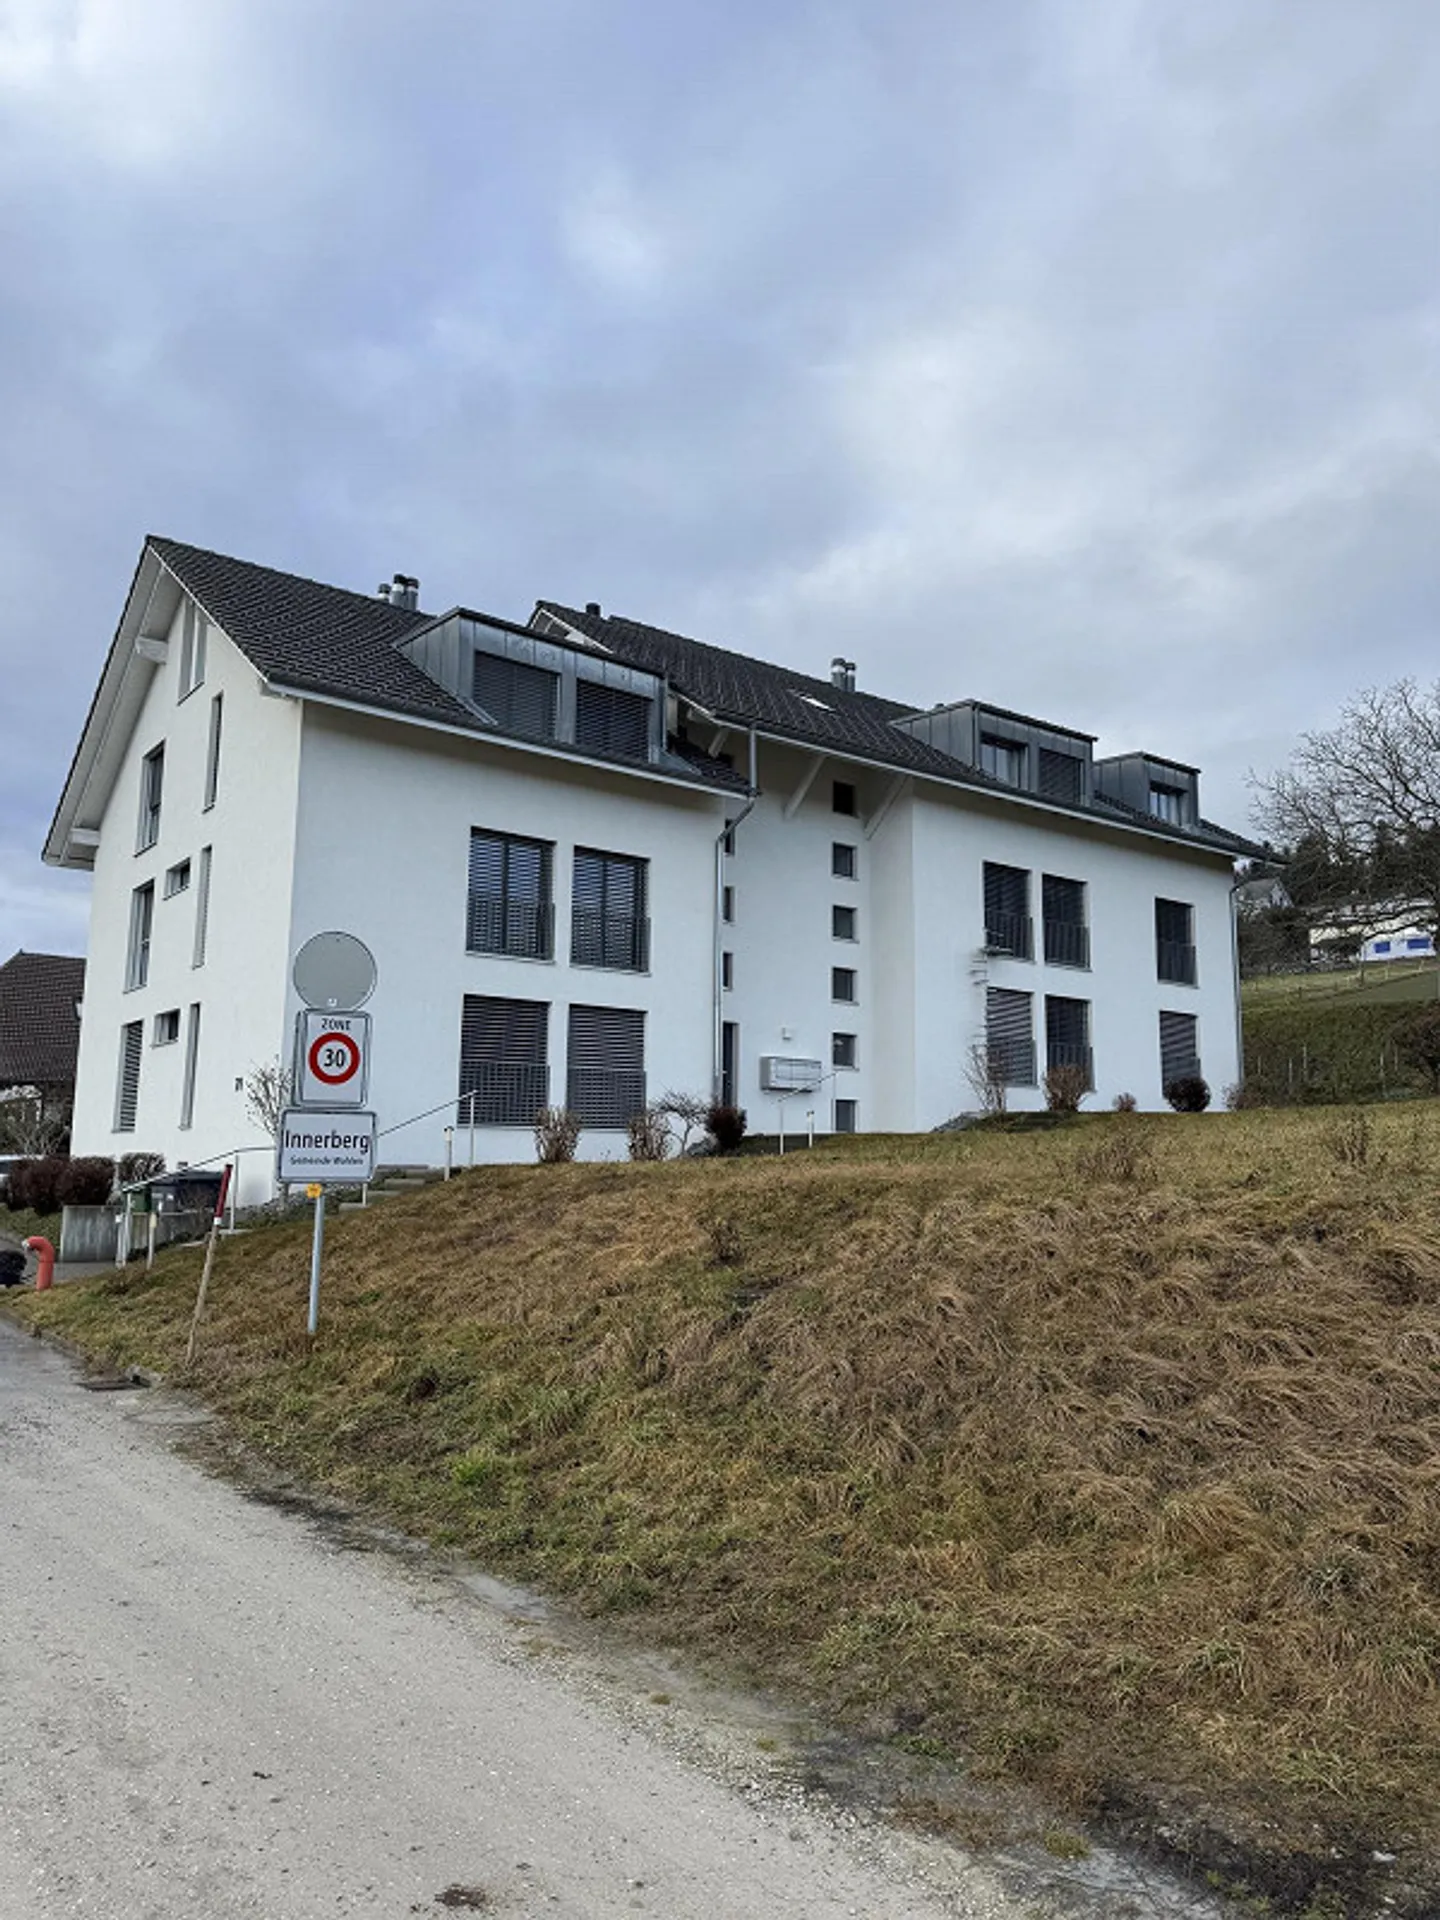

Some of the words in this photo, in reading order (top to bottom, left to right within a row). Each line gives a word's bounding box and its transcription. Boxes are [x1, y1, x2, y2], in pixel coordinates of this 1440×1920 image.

[321, 1018, 351, 1030] ZONE
[324, 1048, 345, 1068] 30
[285, 1129, 371, 1155] Innerberg
